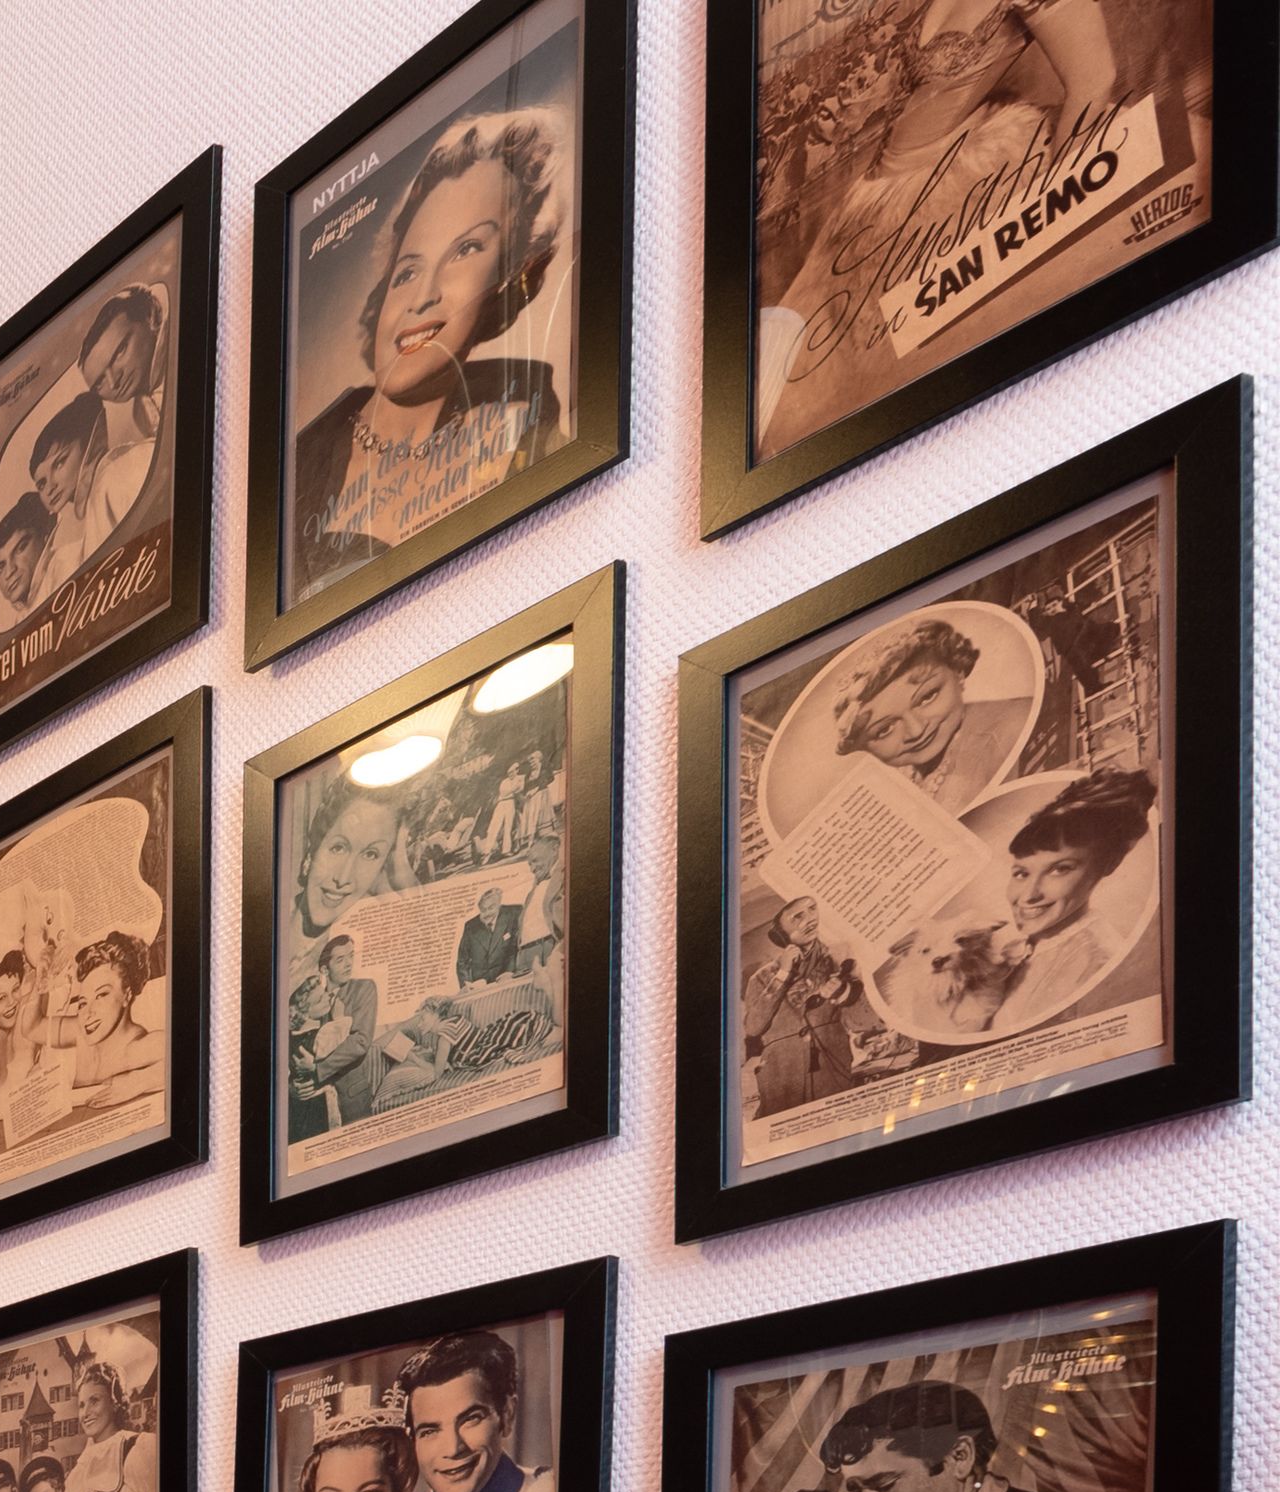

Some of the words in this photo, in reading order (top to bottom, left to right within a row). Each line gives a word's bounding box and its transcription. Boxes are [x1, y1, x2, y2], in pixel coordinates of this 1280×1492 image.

[312, 151, 380, 214] NYTTJA
[1130, 183, 1194, 233] HERZOG
[867, 310, 908, 349] in
[915, 247, 985, 317] SAN
[994, 151, 1119, 262] REMO
[20, 620, 53, 668] vom
[52, 538, 161, 653] Varieté
